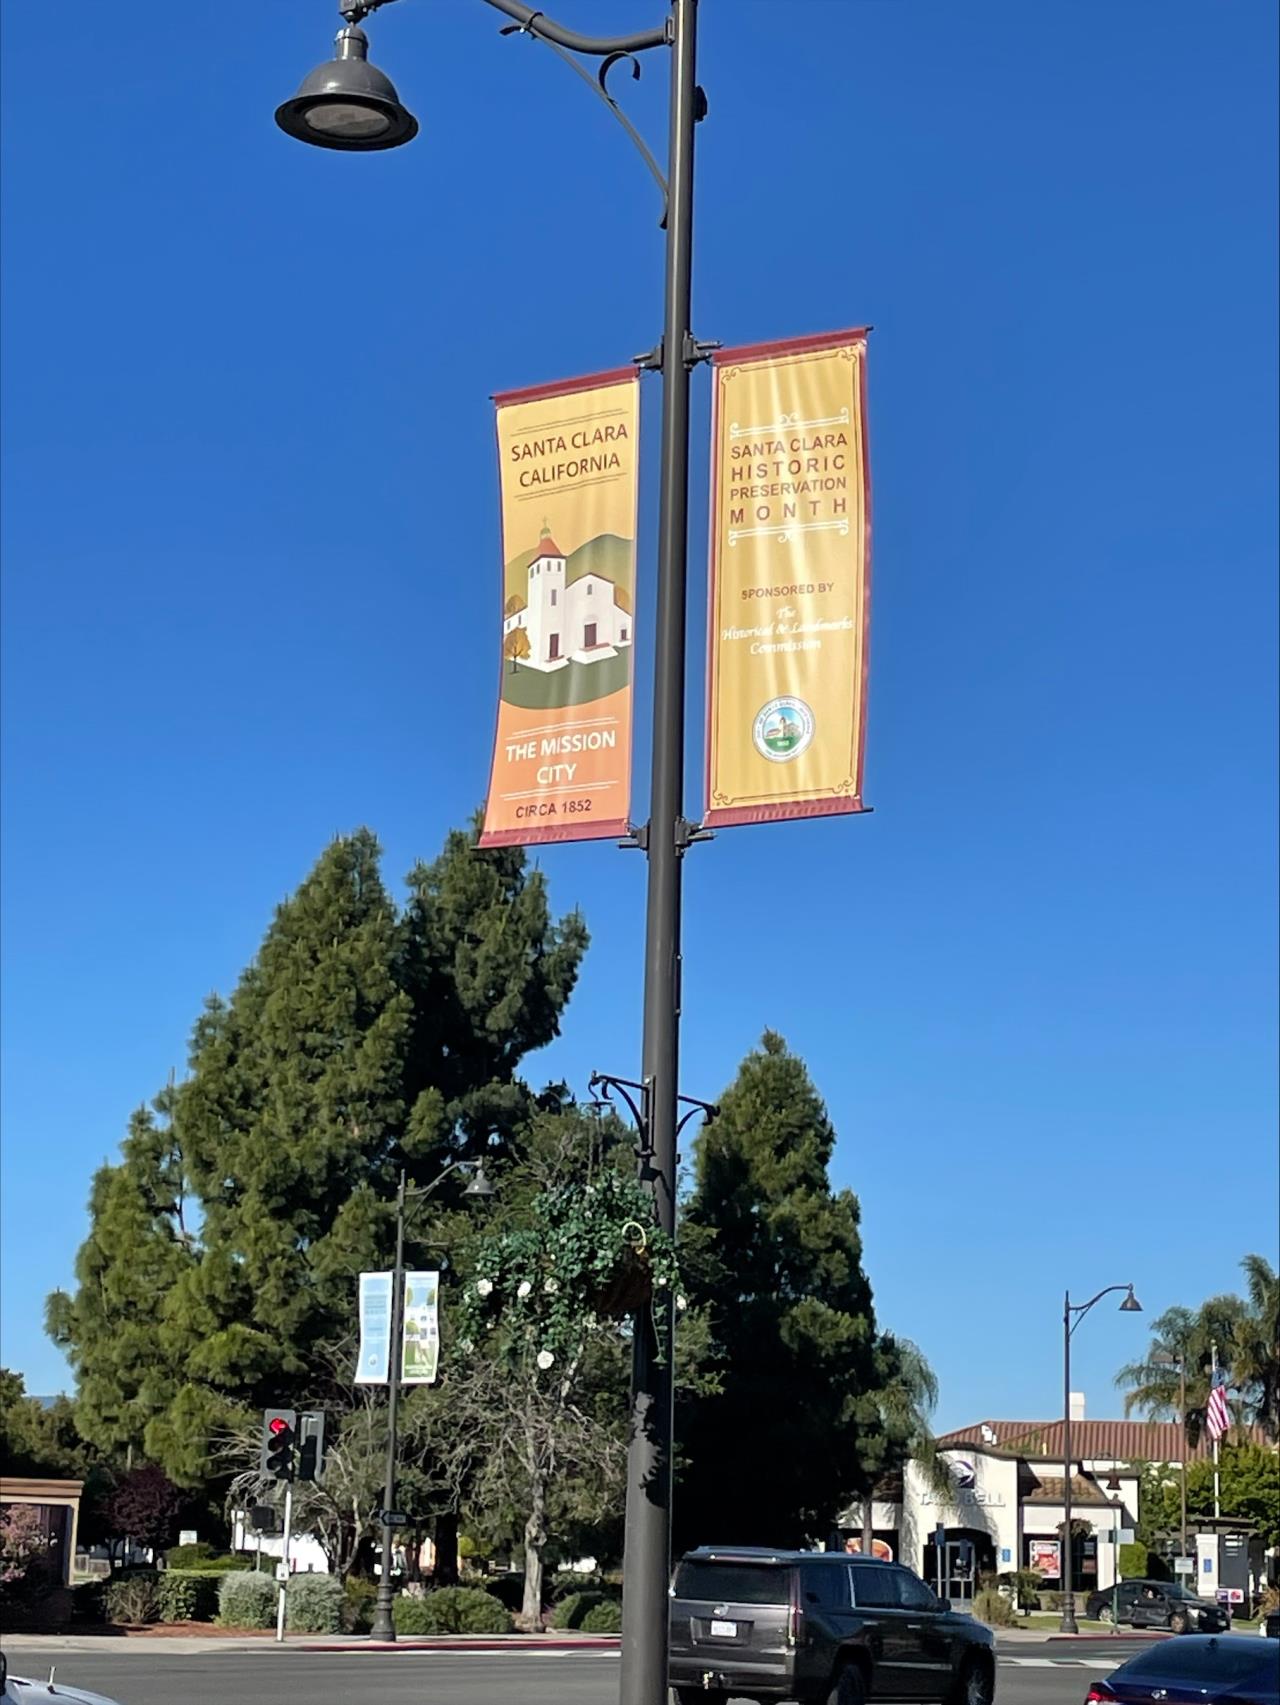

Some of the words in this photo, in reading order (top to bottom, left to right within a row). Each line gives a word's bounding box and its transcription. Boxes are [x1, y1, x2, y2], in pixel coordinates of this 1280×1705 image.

[511, 436, 567, 462] SANTA
[571, 423, 628, 449] CLARA
[731, 440, 786, 460] SANTA
[790, 432, 848, 452] CLARA
[519, 452, 621, 487] CALIFORNIA
[731, 454, 845, 482] HISTORIC
[730, 476, 847, 501] PRESERVATION
[730, 497, 846, 524] MONTH
[741, 583, 815, 600] SPONSORED
[818, 581, 835, 594] BY
[505, 741, 537, 762] THE
[540, 730, 616, 756] MISSION
[536, 763, 577, 784] CITY
[515, 802, 557, 819] CIRCA
[562, 799, 592, 814] 1852
